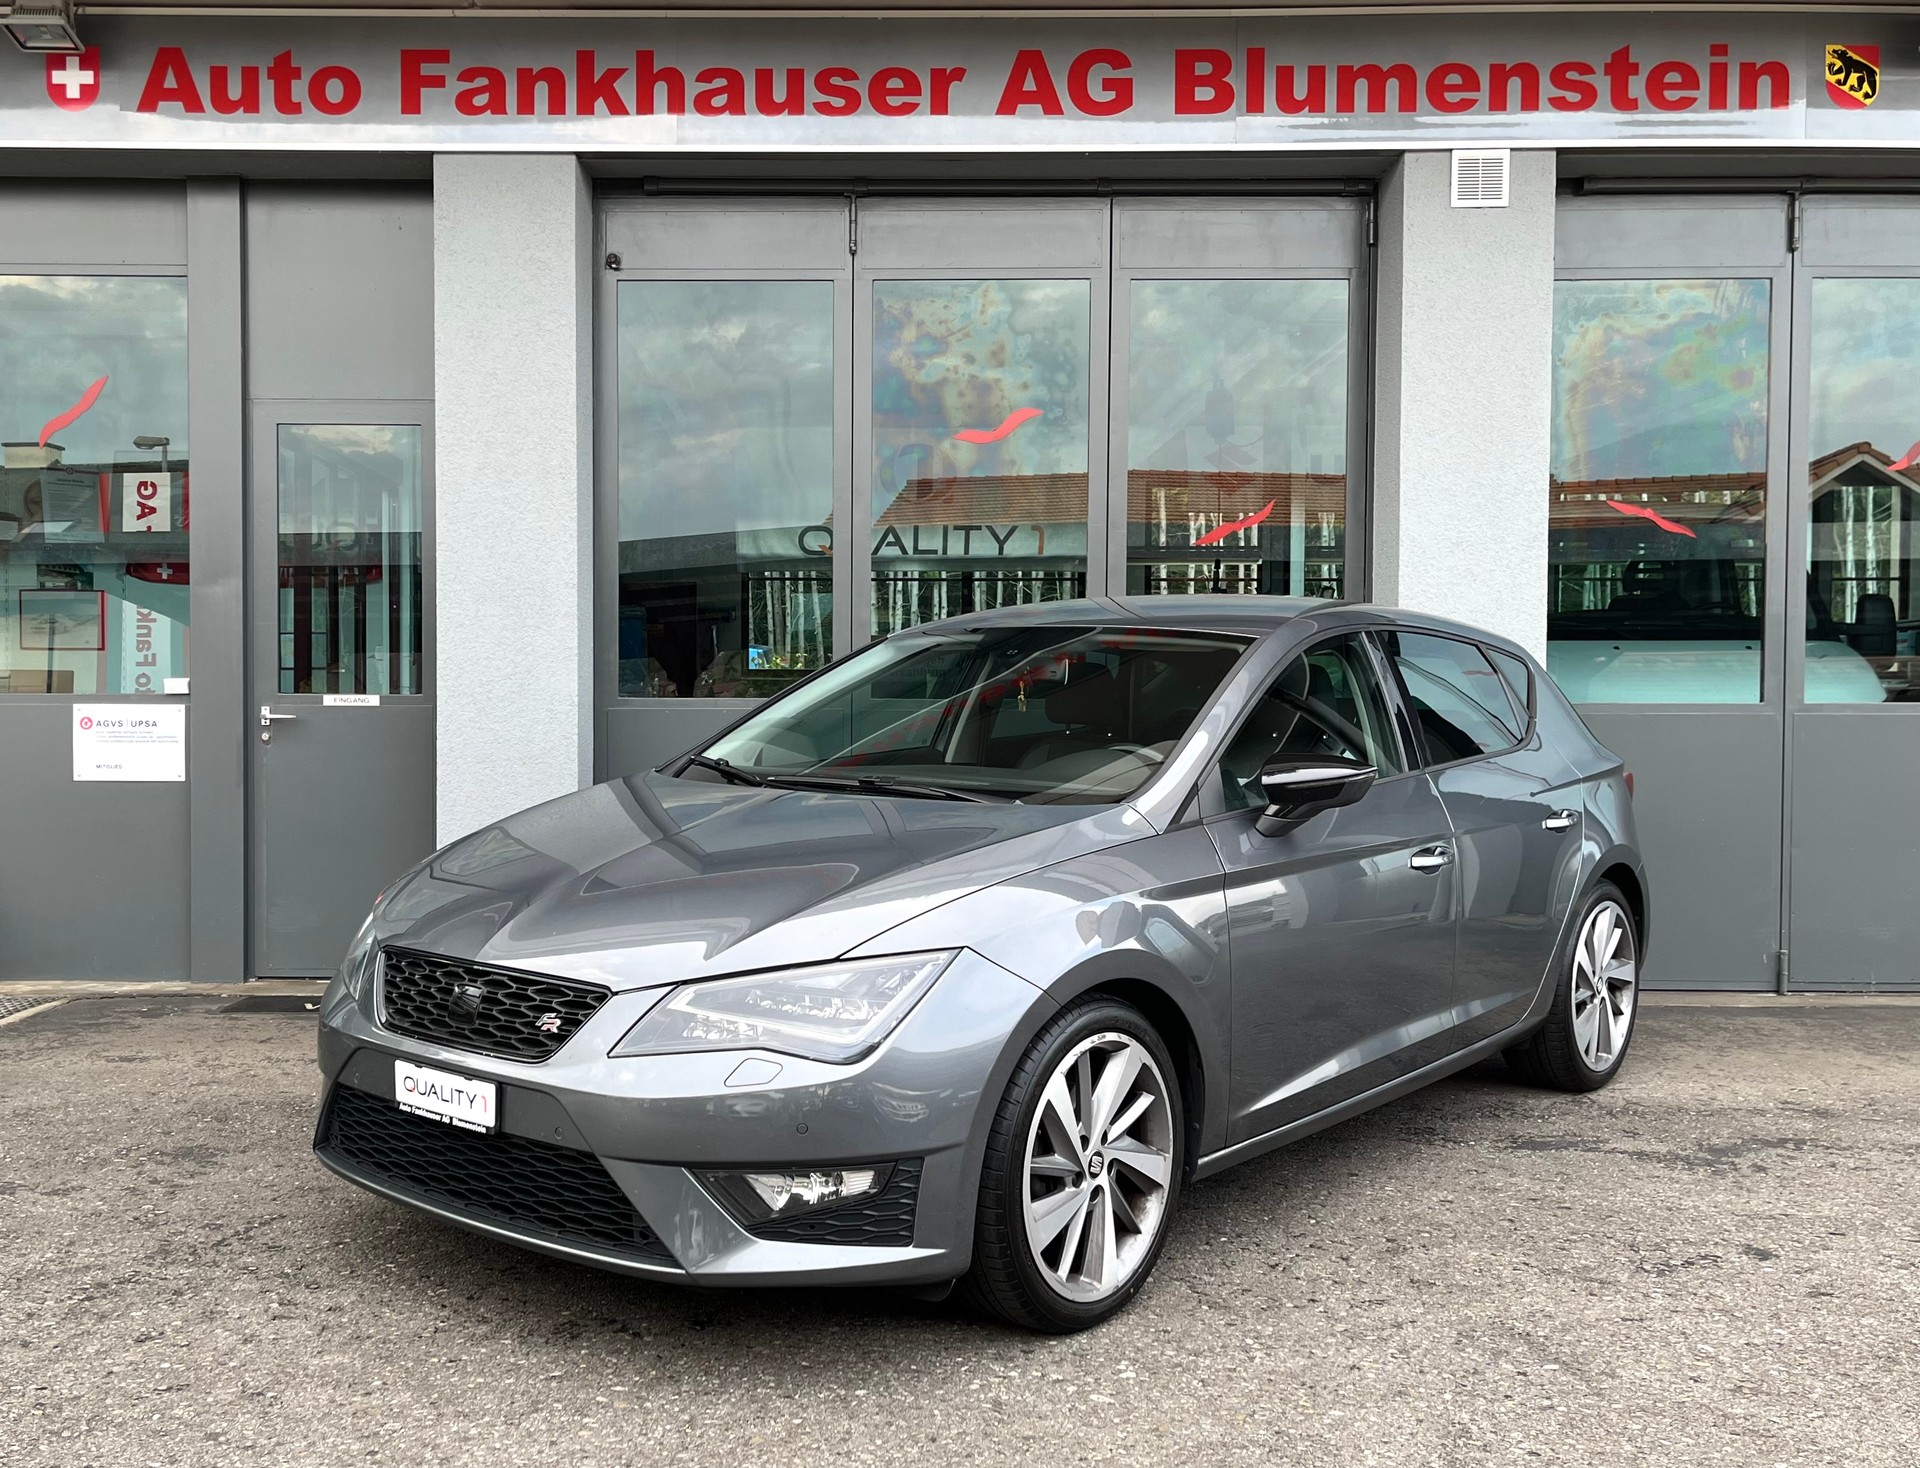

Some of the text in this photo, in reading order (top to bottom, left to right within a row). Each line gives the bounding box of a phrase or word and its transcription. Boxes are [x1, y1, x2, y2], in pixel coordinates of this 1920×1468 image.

[138, 45, 1791, 117] Auto Fankhauser AG Blumenstein
[798, 524, 1019, 557] QALITY
[95, 719, 158, 728] AGVS UPSA
[403, 1075, 488, 1113] QUALITY 1
